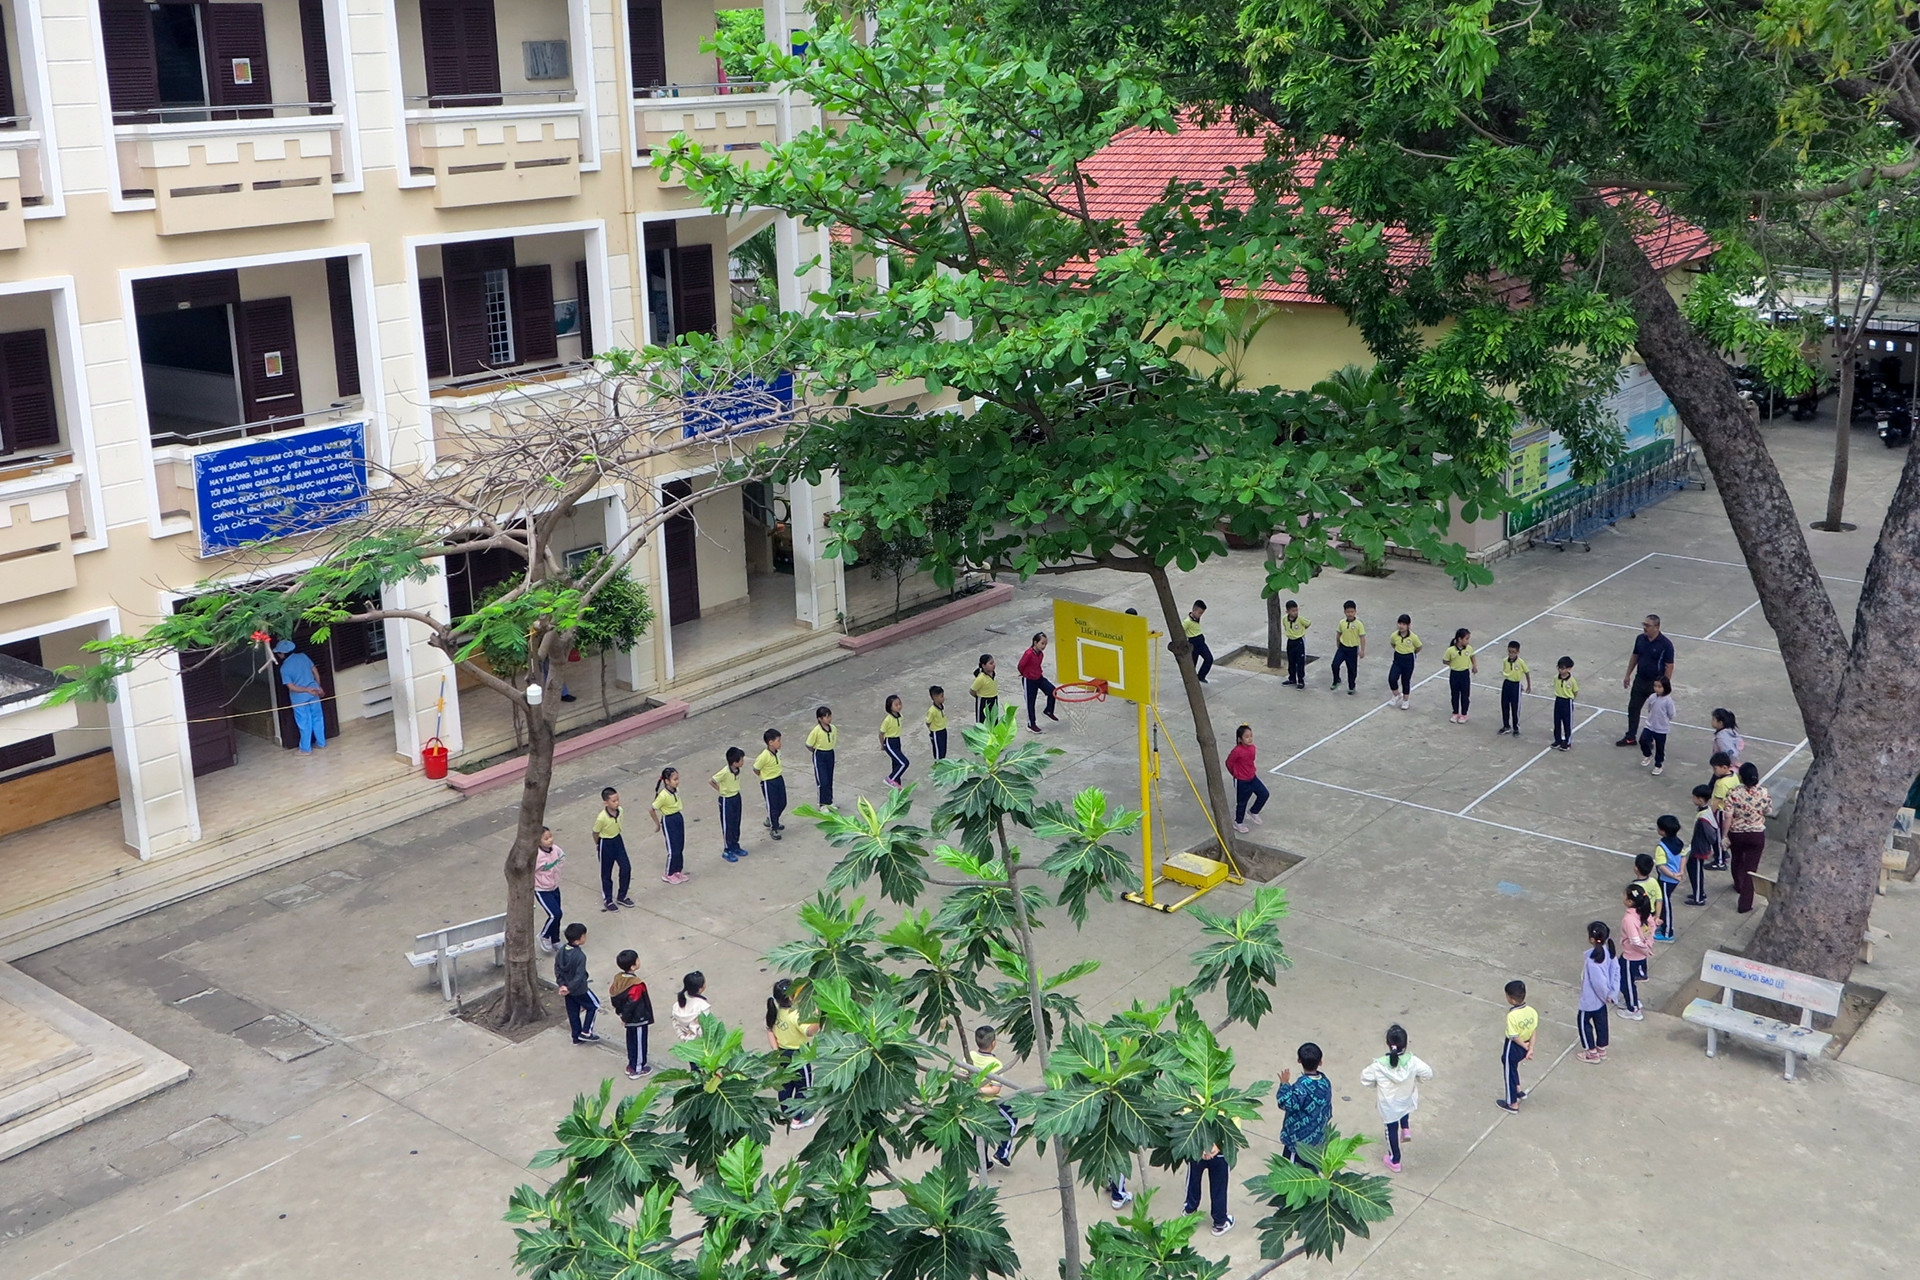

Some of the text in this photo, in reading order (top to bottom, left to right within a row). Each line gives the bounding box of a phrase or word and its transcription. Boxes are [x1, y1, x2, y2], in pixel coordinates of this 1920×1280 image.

[228, 460, 248, 470] SÔNG
[308, 444, 323, 453] NÊN
[209, 478, 224, 486] HAY
[304, 457, 320, 466] NAM
[236, 482, 253, 491] VINH
[254, 476, 281, 487] QUANG
[314, 467, 325, 475] VAI
[316, 478, 329, 486] HAY
[1074, 618, 1087, 626] Sun
[1081, 626, 1124, 641] Life Financial
